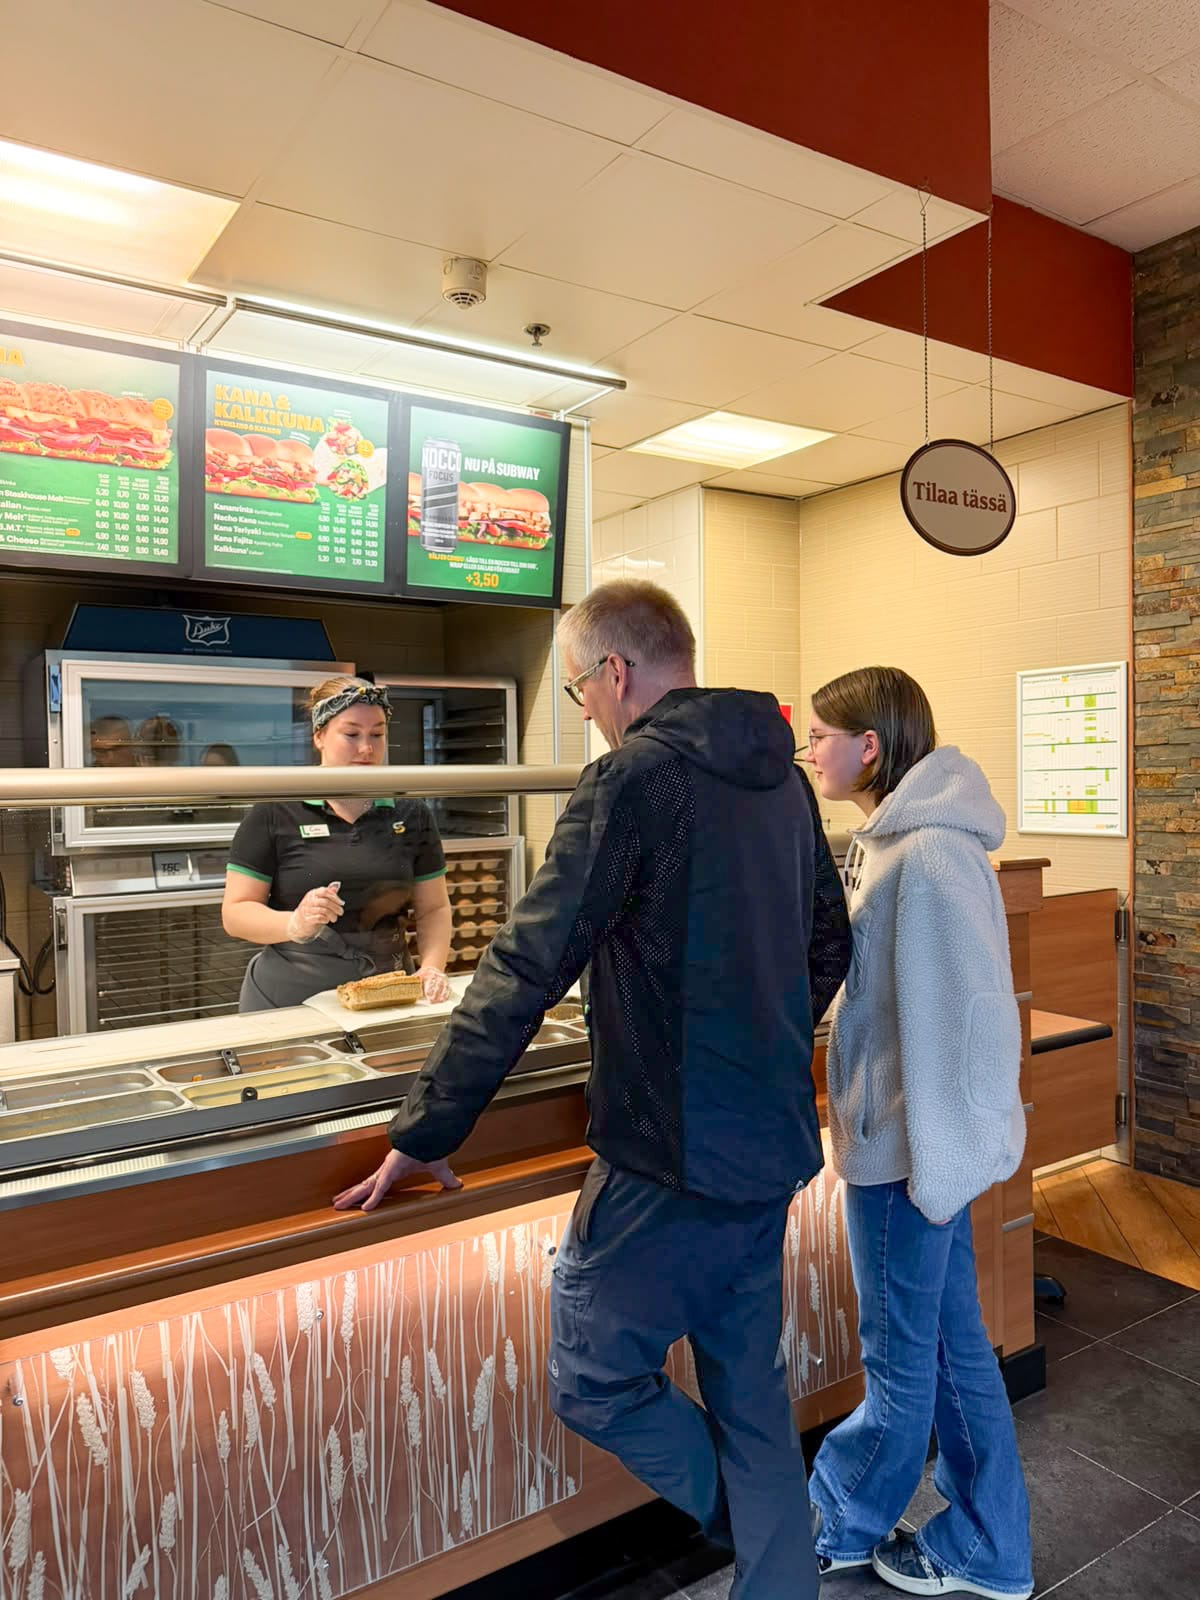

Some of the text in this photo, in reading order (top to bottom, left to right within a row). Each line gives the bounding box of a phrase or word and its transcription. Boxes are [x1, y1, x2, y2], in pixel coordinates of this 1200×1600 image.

[214, 383, 291, 410] KANA &
[213, 401, 324, 433] KALKKUNA
[464, 457, 540, 480] NU PÅ SUBWAY
[429, 470, 454, 482] FOCUS
[913, 481, 1007, 513] Tilaa tässä
[153, 505, 169, 513] 14,40
[214, 503, 253, 514] Kananrinta
[153, 516, 169, 524] 14,40
[214, 513, 237, 522] Nacho
[238, 516, 257, 525] Kana
[214, 524, 232, 532] Kana
[233, 526, 262, 535] Teriyaki
[7, 535, 39, 545] Cheese
[214, 534, 232, 543] Kana
[233, 536, 253, 545] Fajita
[465, 571, 499, 588] +3,50
[192, 621, 223, 639] Duke
